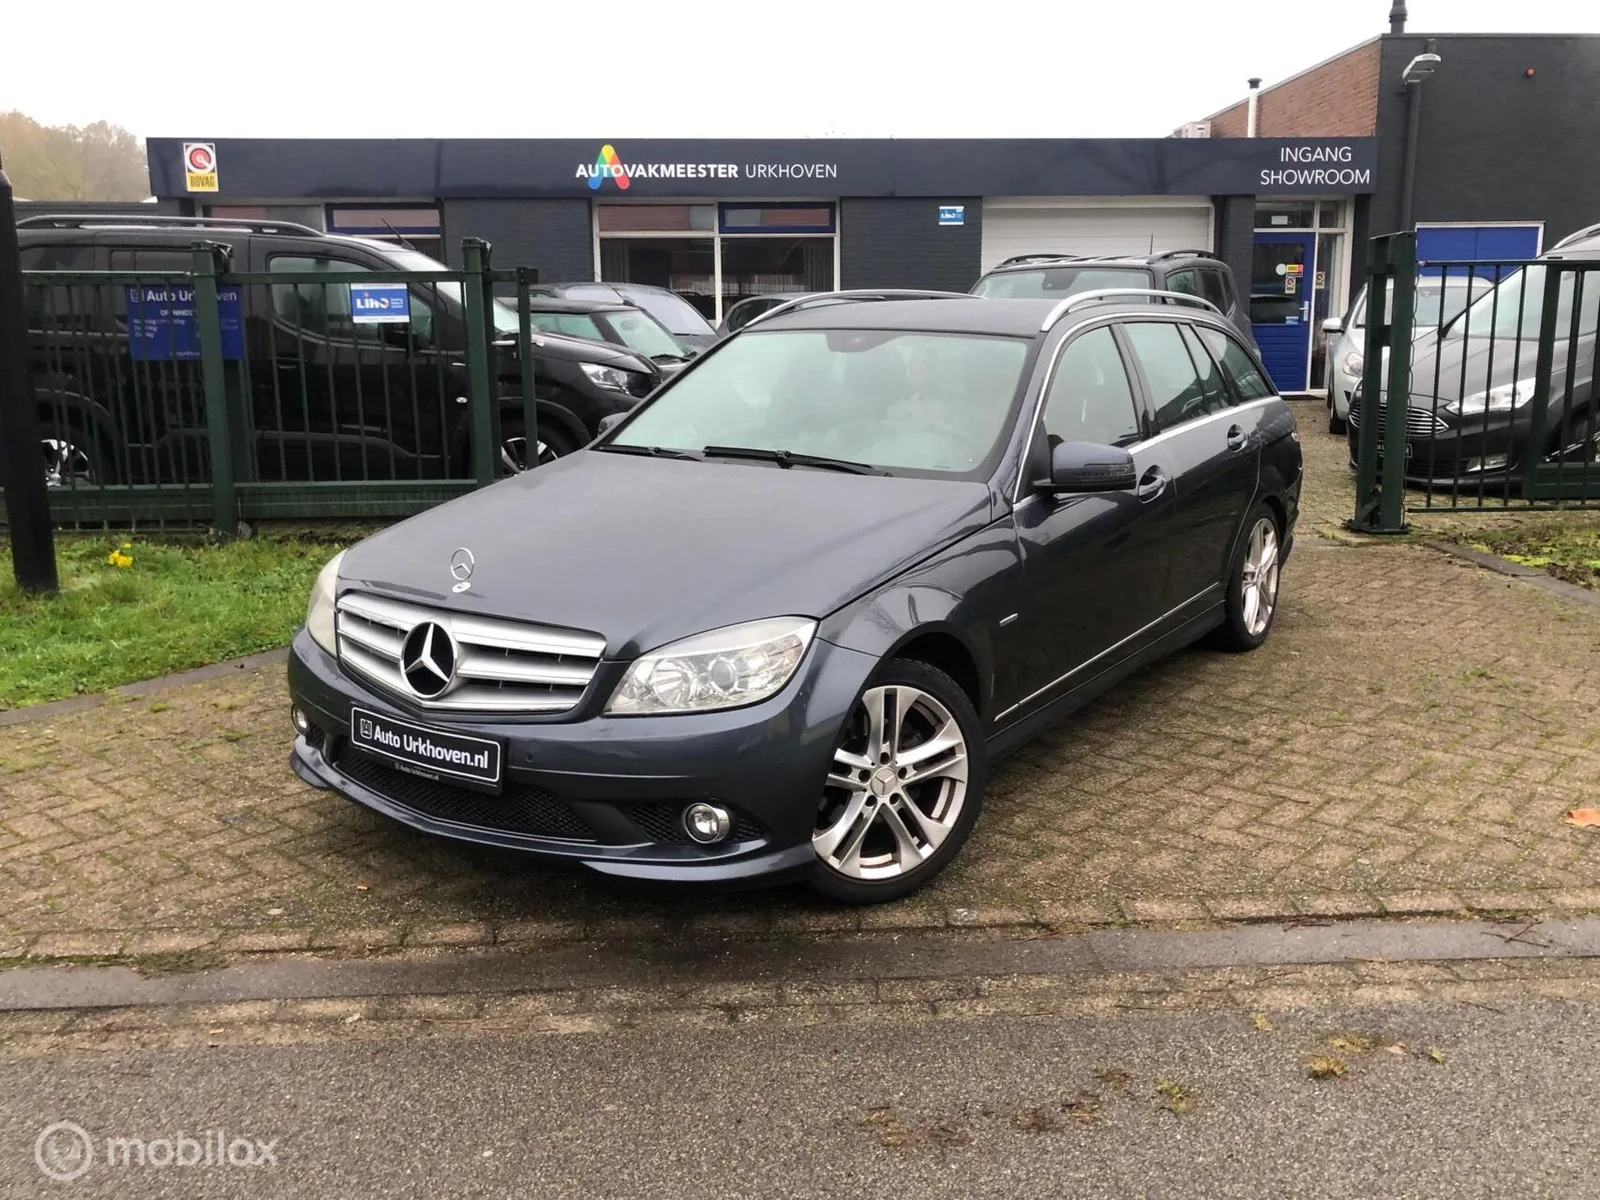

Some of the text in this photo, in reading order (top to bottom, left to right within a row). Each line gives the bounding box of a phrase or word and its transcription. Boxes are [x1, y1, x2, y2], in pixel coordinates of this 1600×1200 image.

[1280, 146, 1352, 162] INGANG
[575, 163, 837, 179] AUTOVAKMEESTER URKHOVEN
[1260, 169, 1371, 185] SHOWROOM
[190, 175, 215, 188] BOVAG
[179, 289, 237, 302] Urven
[374, 725, 489, 769] Auto Urkhoven.nl
